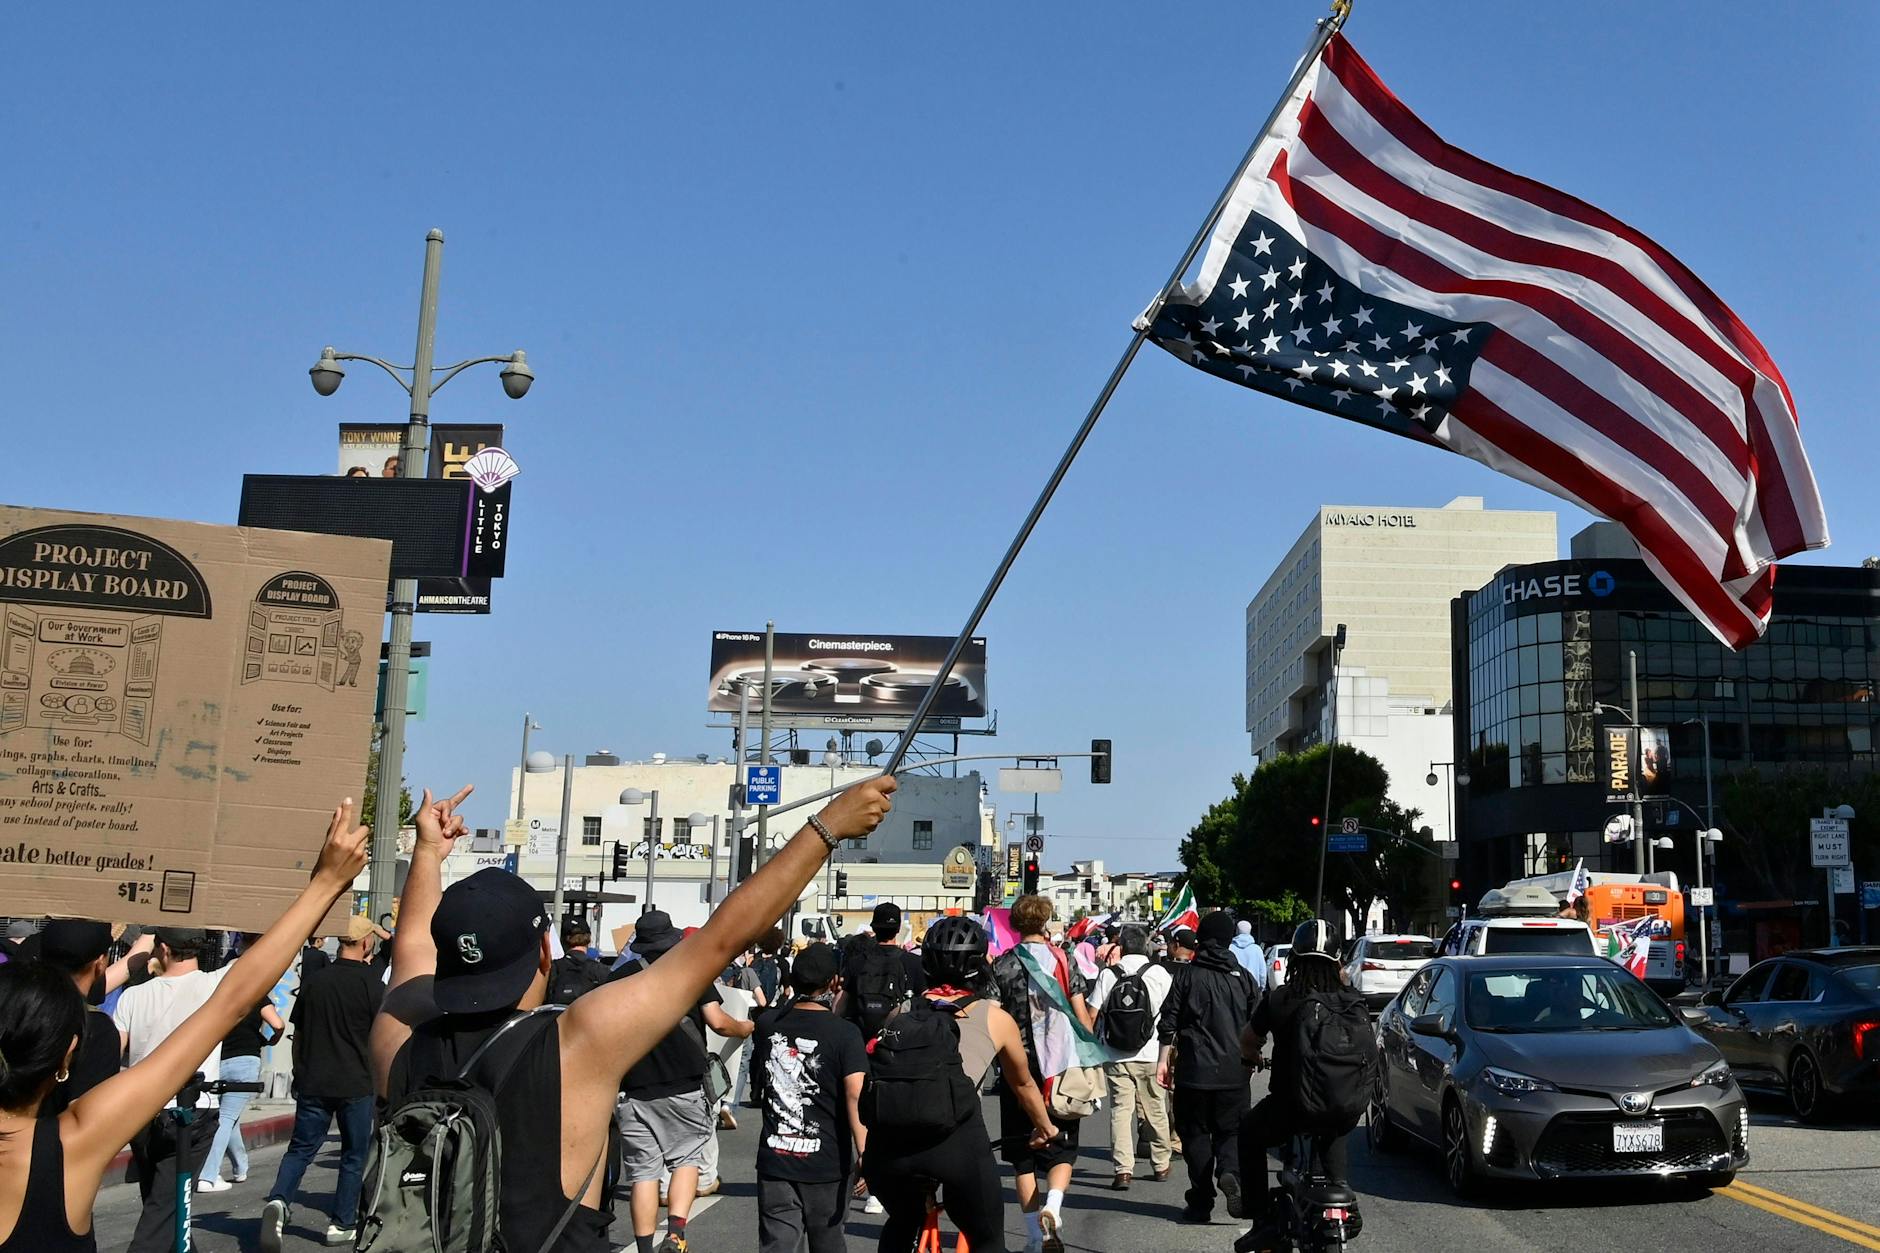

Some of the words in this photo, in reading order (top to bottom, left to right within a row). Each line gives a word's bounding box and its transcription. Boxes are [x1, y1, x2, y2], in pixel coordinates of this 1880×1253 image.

[342, 431, 366, 443] TONY
[475, 499, 485, 554] LITTLE
[492, 504, 503, 549] TOKYO
[1325, 513, 1375, 526] MIYAKO
[1378, 513, 1416, 527] HOTEL
[32, 542, 153, 571] PROJECT
[102, 574, 189, 601] BOARD
[282, 579, 318, 592] PROJECT
[1502, 574, 1582, 605] CHASE
[267, 590, 301, 602] DISPLAY
[301, 593, 330, 605] BOARD
[48, 621, 65, 632] Our
[67, 621, 122, 636] Government
[64, 632, 75, 641] at
[78, 633, 104, 643] Work
[720, 632, 742, 641] iPhone
[750, 634, 760, 642] Pro
[808, 639, 894, 652] Cinemasterpiece.
[271, 703, 286, 713] Use
[286, 703, 303, 714] for:
[265, 719, 286, 728] Science
[287, 721, 299, 729] Fair
[53, 735, 71, 746] Use
[74, 736, 93, 748] for:
[280, 730, 304, 739] Projects
[108, 754, 158, 769] timelines,
[1609, 732, 1629, 789] PARADE
[32, 779, 54, 795] Arts
[56, 781, 67, 795] &
[751, 776, 776, 785] PUBLIC
[749, 784, 777, 793] PARKING
[19, 797, 55, 810] school
[100, 803, 134, 816] really!
[3, 815, 21, 824] use
[23, 813, 60, 827] instead
[62, 815, 76, 828] of
[74, 817, 106, 831] poster
[108, 818, 139, 832] board.
[0, 842, 40, 864] ate
[45, 847, 92, 867] better
[1009, 847, 1020, 876] PARADE
[1652, 892, 1660, 900] 30
[1616, 1134, 1661, 1147] 7YXS678
